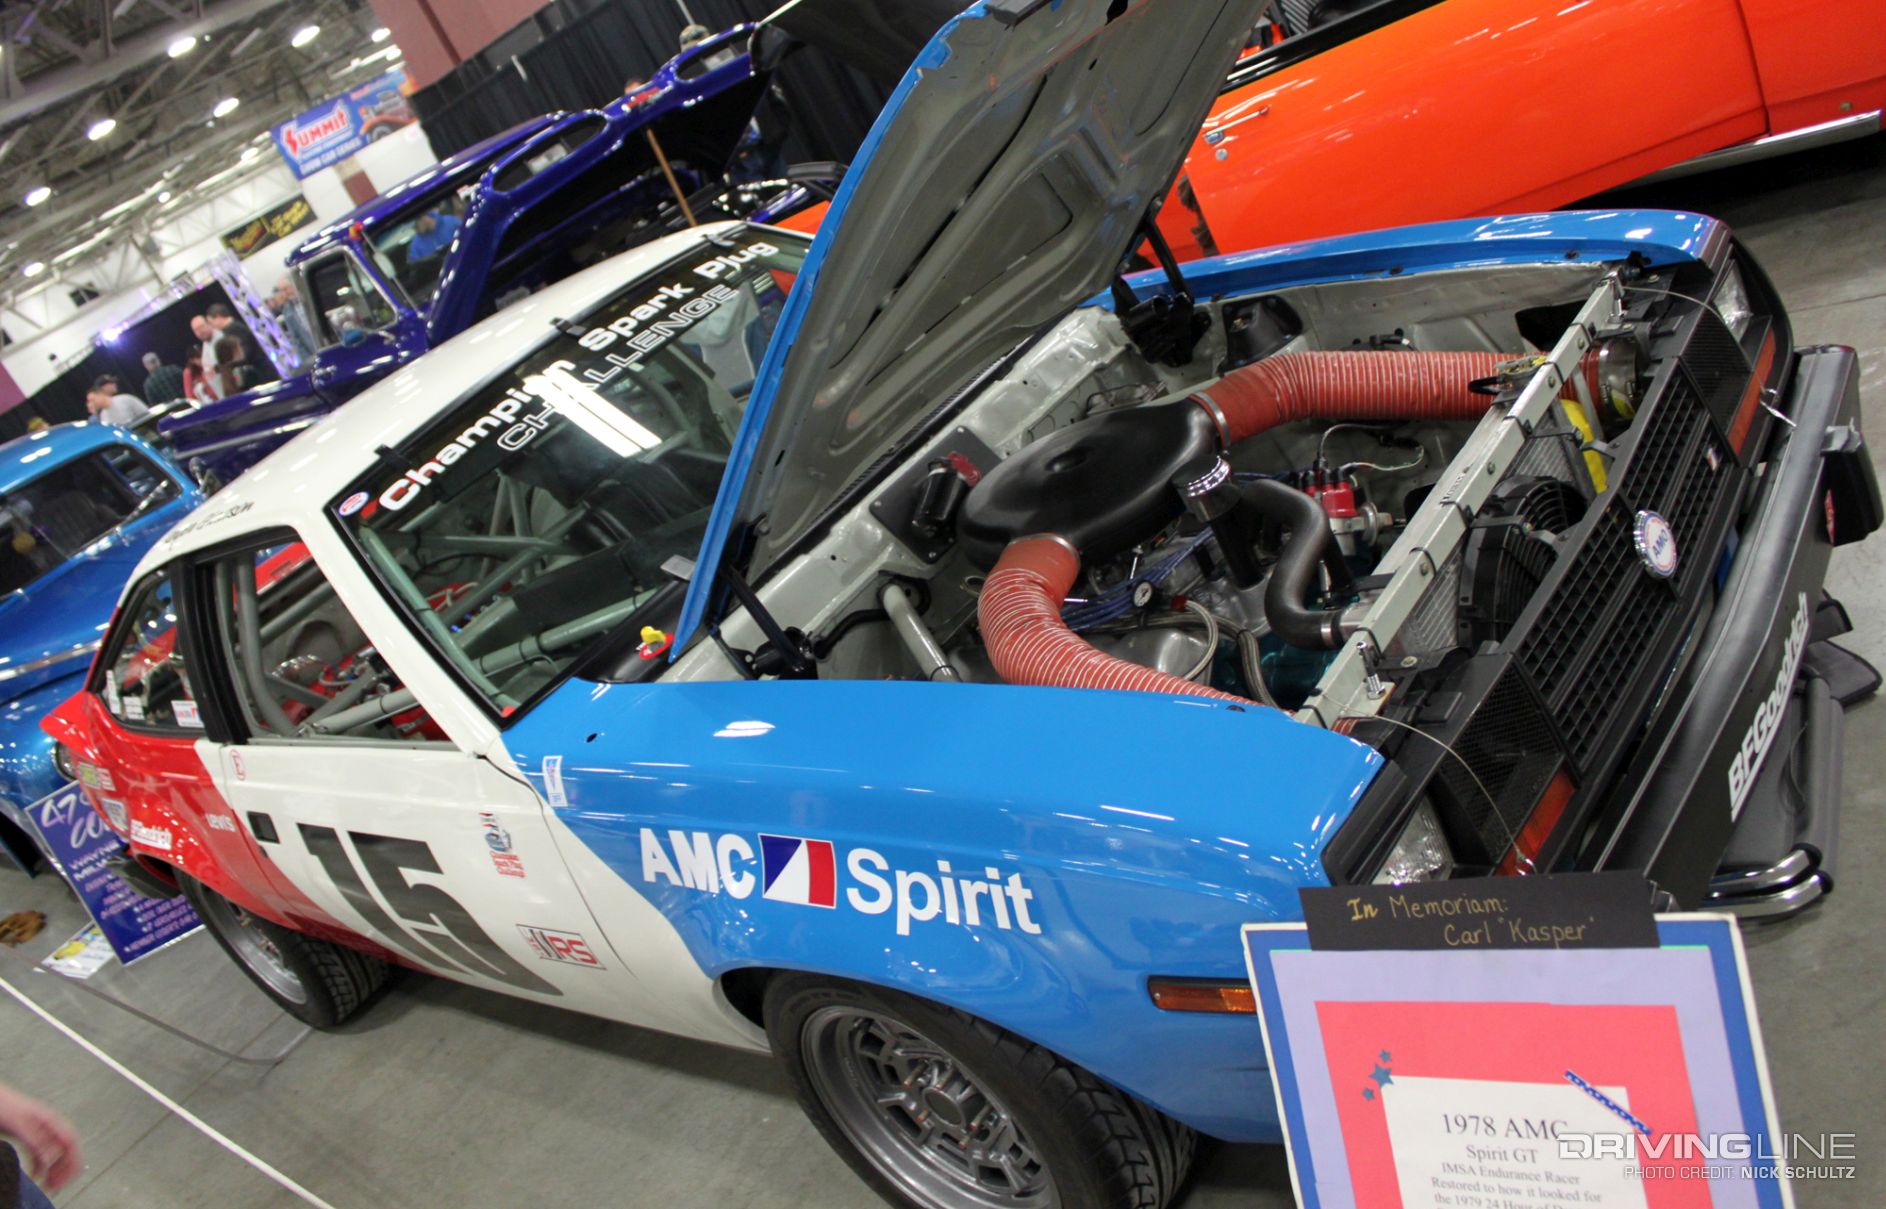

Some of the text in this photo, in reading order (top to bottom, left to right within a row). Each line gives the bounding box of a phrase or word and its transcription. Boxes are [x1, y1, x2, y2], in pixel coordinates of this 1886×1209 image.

[283, 105, 349, 157] SUMMIT
[578, 282, 698, 352] Spark
[694, 241, 780, 280] Plug
[497, 284, 740, 450] CHLLENGE
[1652, 528, 1668, 558] AMC
[1728, 591, 1809, 809] BFGoodrich
[639, 828, 1043, 936] AMC Spirit
[295, 822, 565, 996] 15
[1347, 893, 1508, 921] In Memoriam:
[1444, 920, 1493, 946] Carl
[1442, 1113, 1569, 1142] 1978 AMC
[1466, 1144, 1539, 1164] Spirit GT
[1442, 1162, 1581, 1185] IMSA Endurance Racer
[1431, 1176, 1602, 1203] Restored to how it looked for
[1433, 1191, 1451, 1205] the
[1455, 1194, 1482, 1208] 1979
[1485, 1196, 1501, 1209] 24
[1503, 1198, 1535, 1209] Hour
